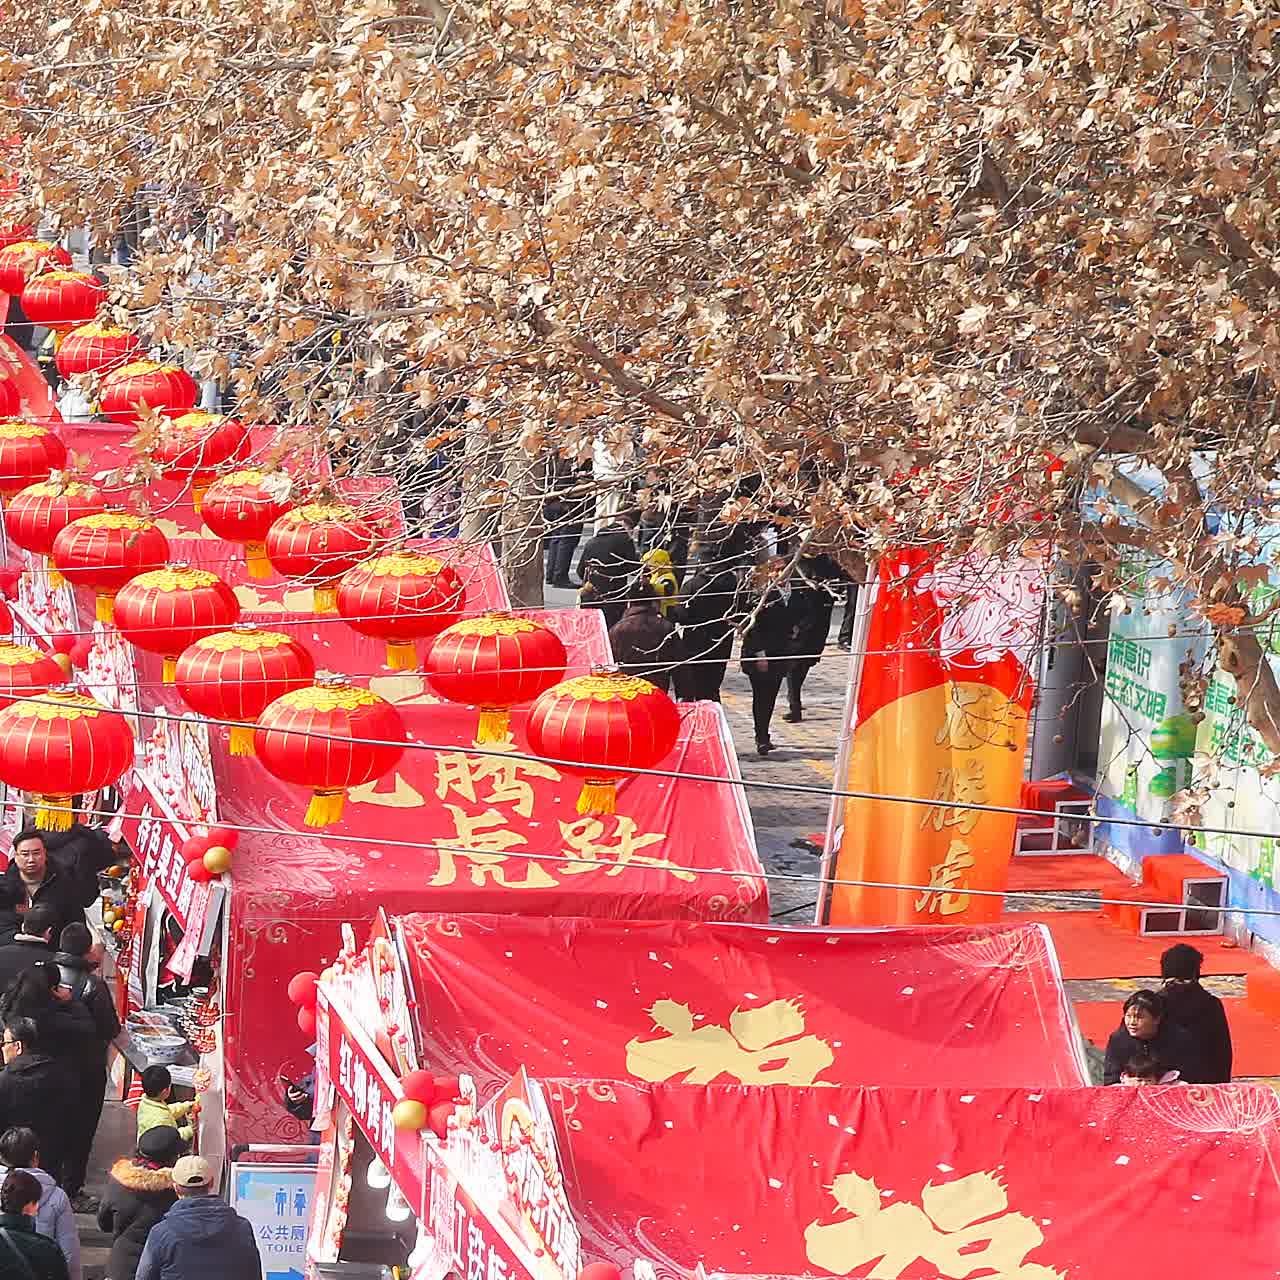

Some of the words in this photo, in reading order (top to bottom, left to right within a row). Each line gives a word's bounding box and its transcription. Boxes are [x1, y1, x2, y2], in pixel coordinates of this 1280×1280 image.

[1105, 671, 1169, 724] 生态文明
[259, 1225, 305, 1241] 公共厕
